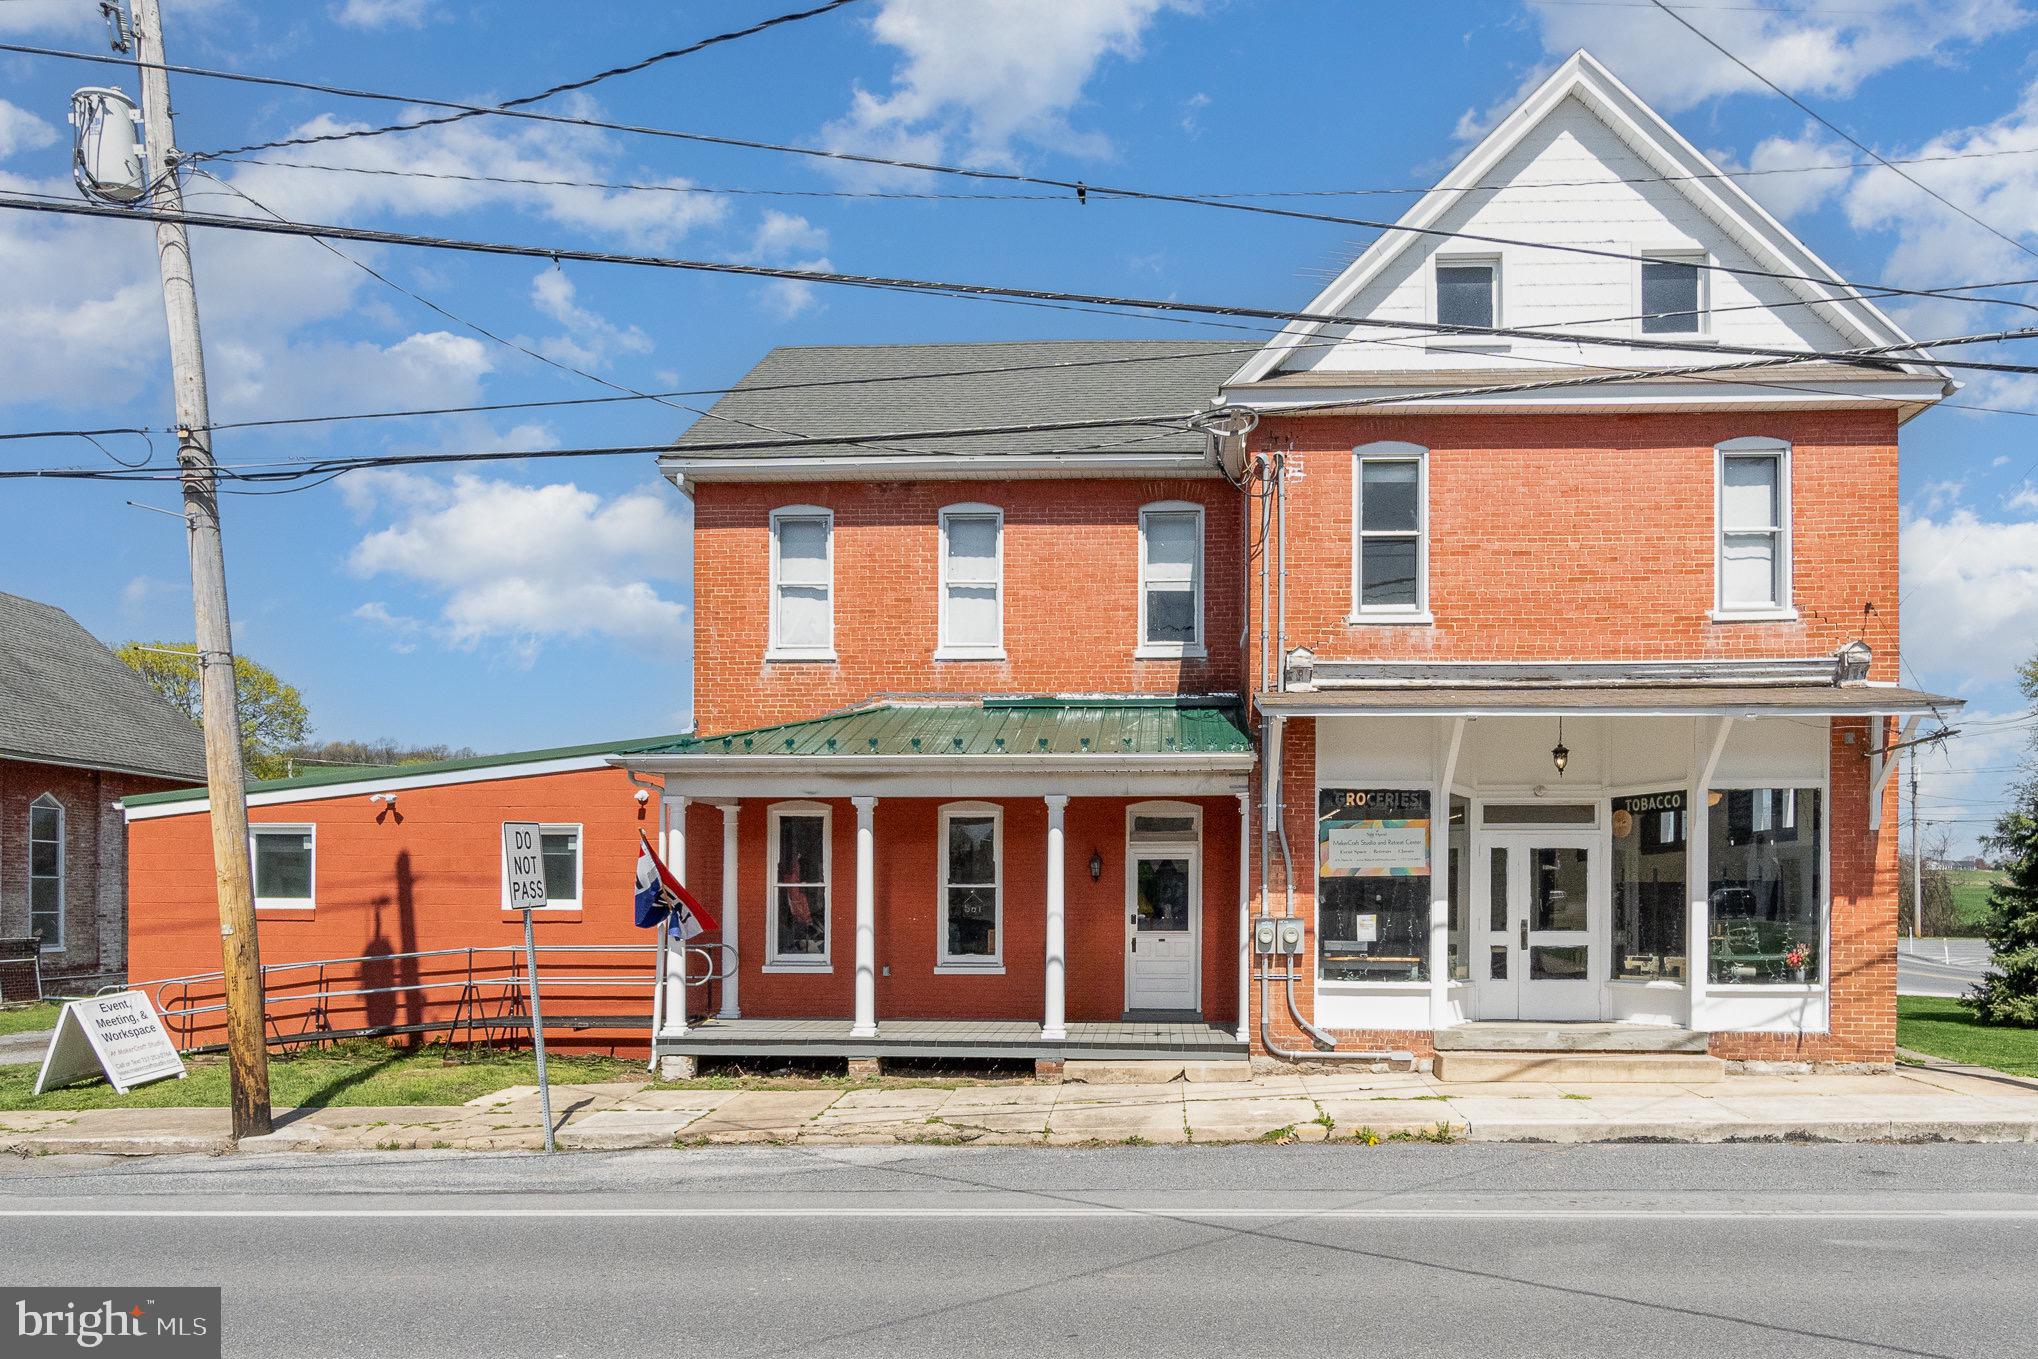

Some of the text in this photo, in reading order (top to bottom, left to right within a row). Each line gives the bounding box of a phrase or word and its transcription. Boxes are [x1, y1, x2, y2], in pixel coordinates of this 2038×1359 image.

[1335, 792, 1420, 807] GROCERIES
[1625, 794, 1681, 812] TOBACCO
[515, 830, 532, 849] DO
[514, 856, 537, 875] NOT
[512, 880, 544, 900] PASS
[99, 999, 132, 1013] Event,
[95, 1010, 148, 1029] Meeting, &
[101, 1024, 157, 1043] Workspace
